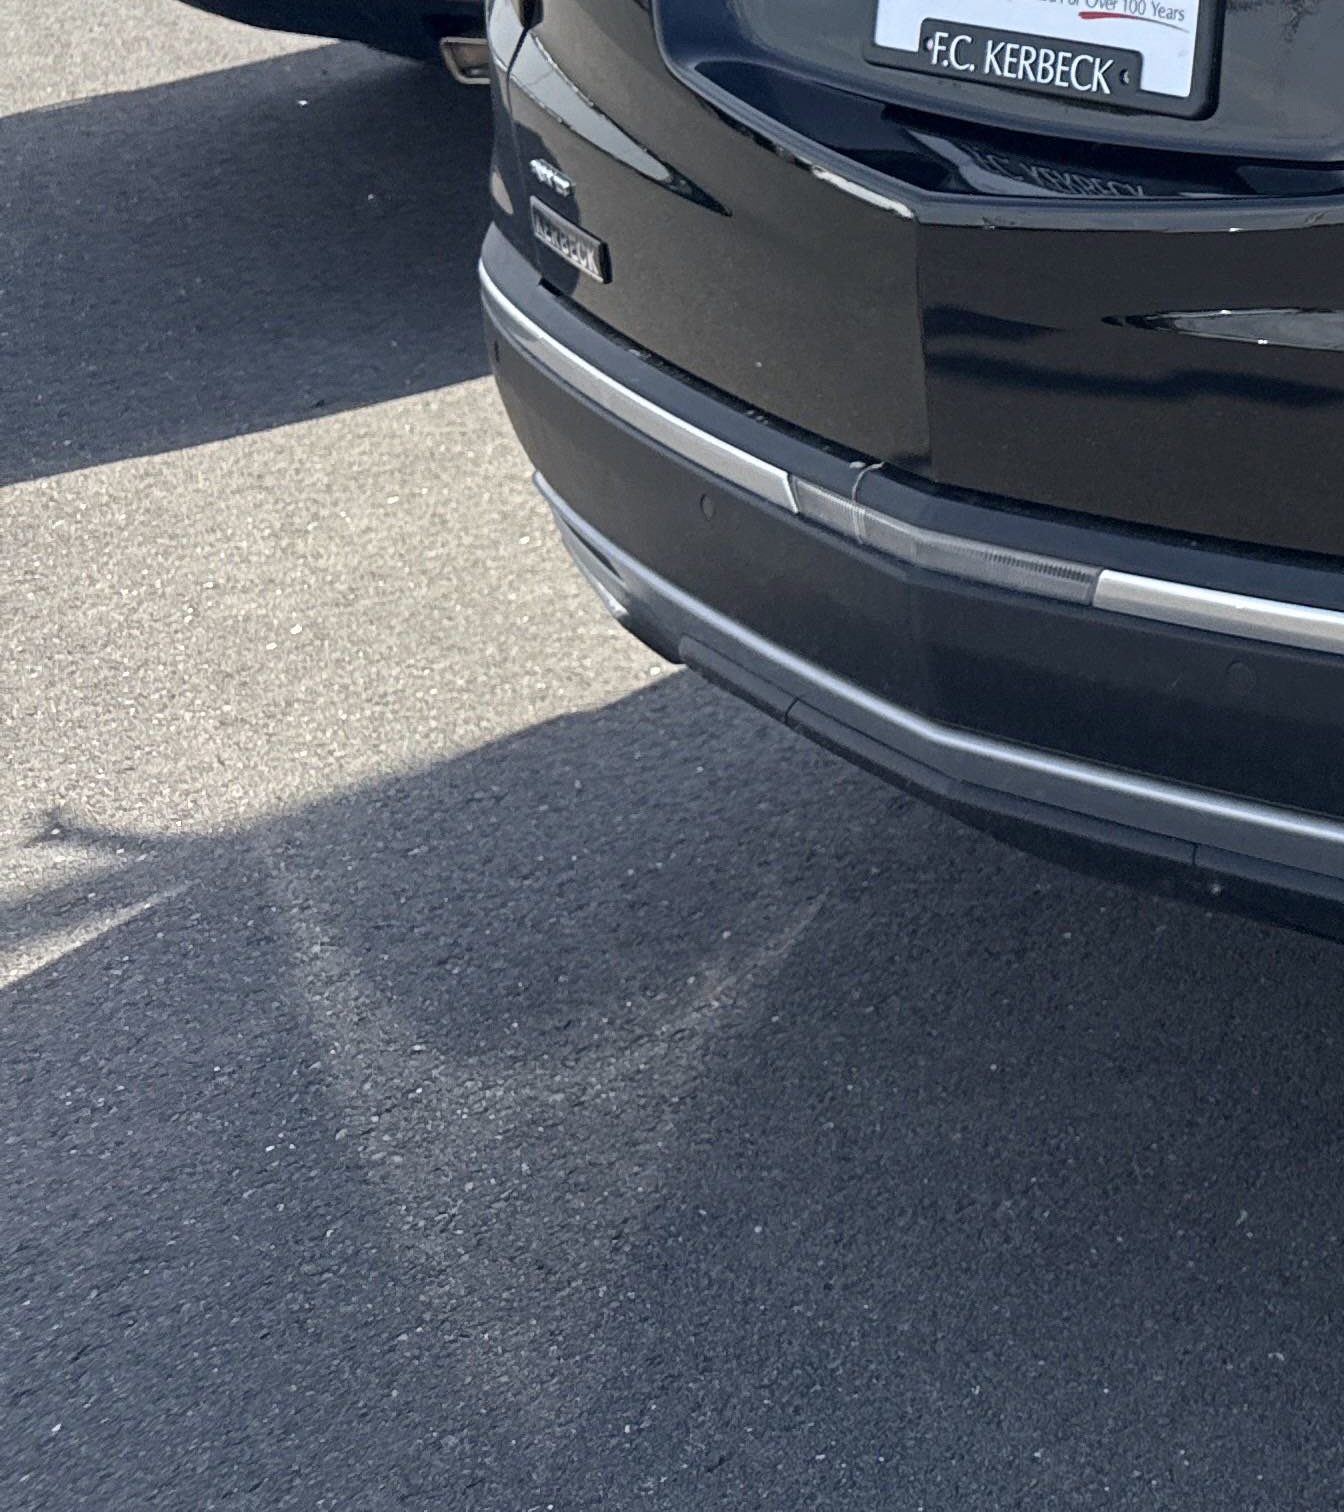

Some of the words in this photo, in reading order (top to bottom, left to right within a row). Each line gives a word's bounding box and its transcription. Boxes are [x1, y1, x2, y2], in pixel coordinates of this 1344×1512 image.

[1152, 0, 1185, 21] Years
[930, 31, 975, 72] F.C.
[983, 40, 1114, 94] KERBECK
